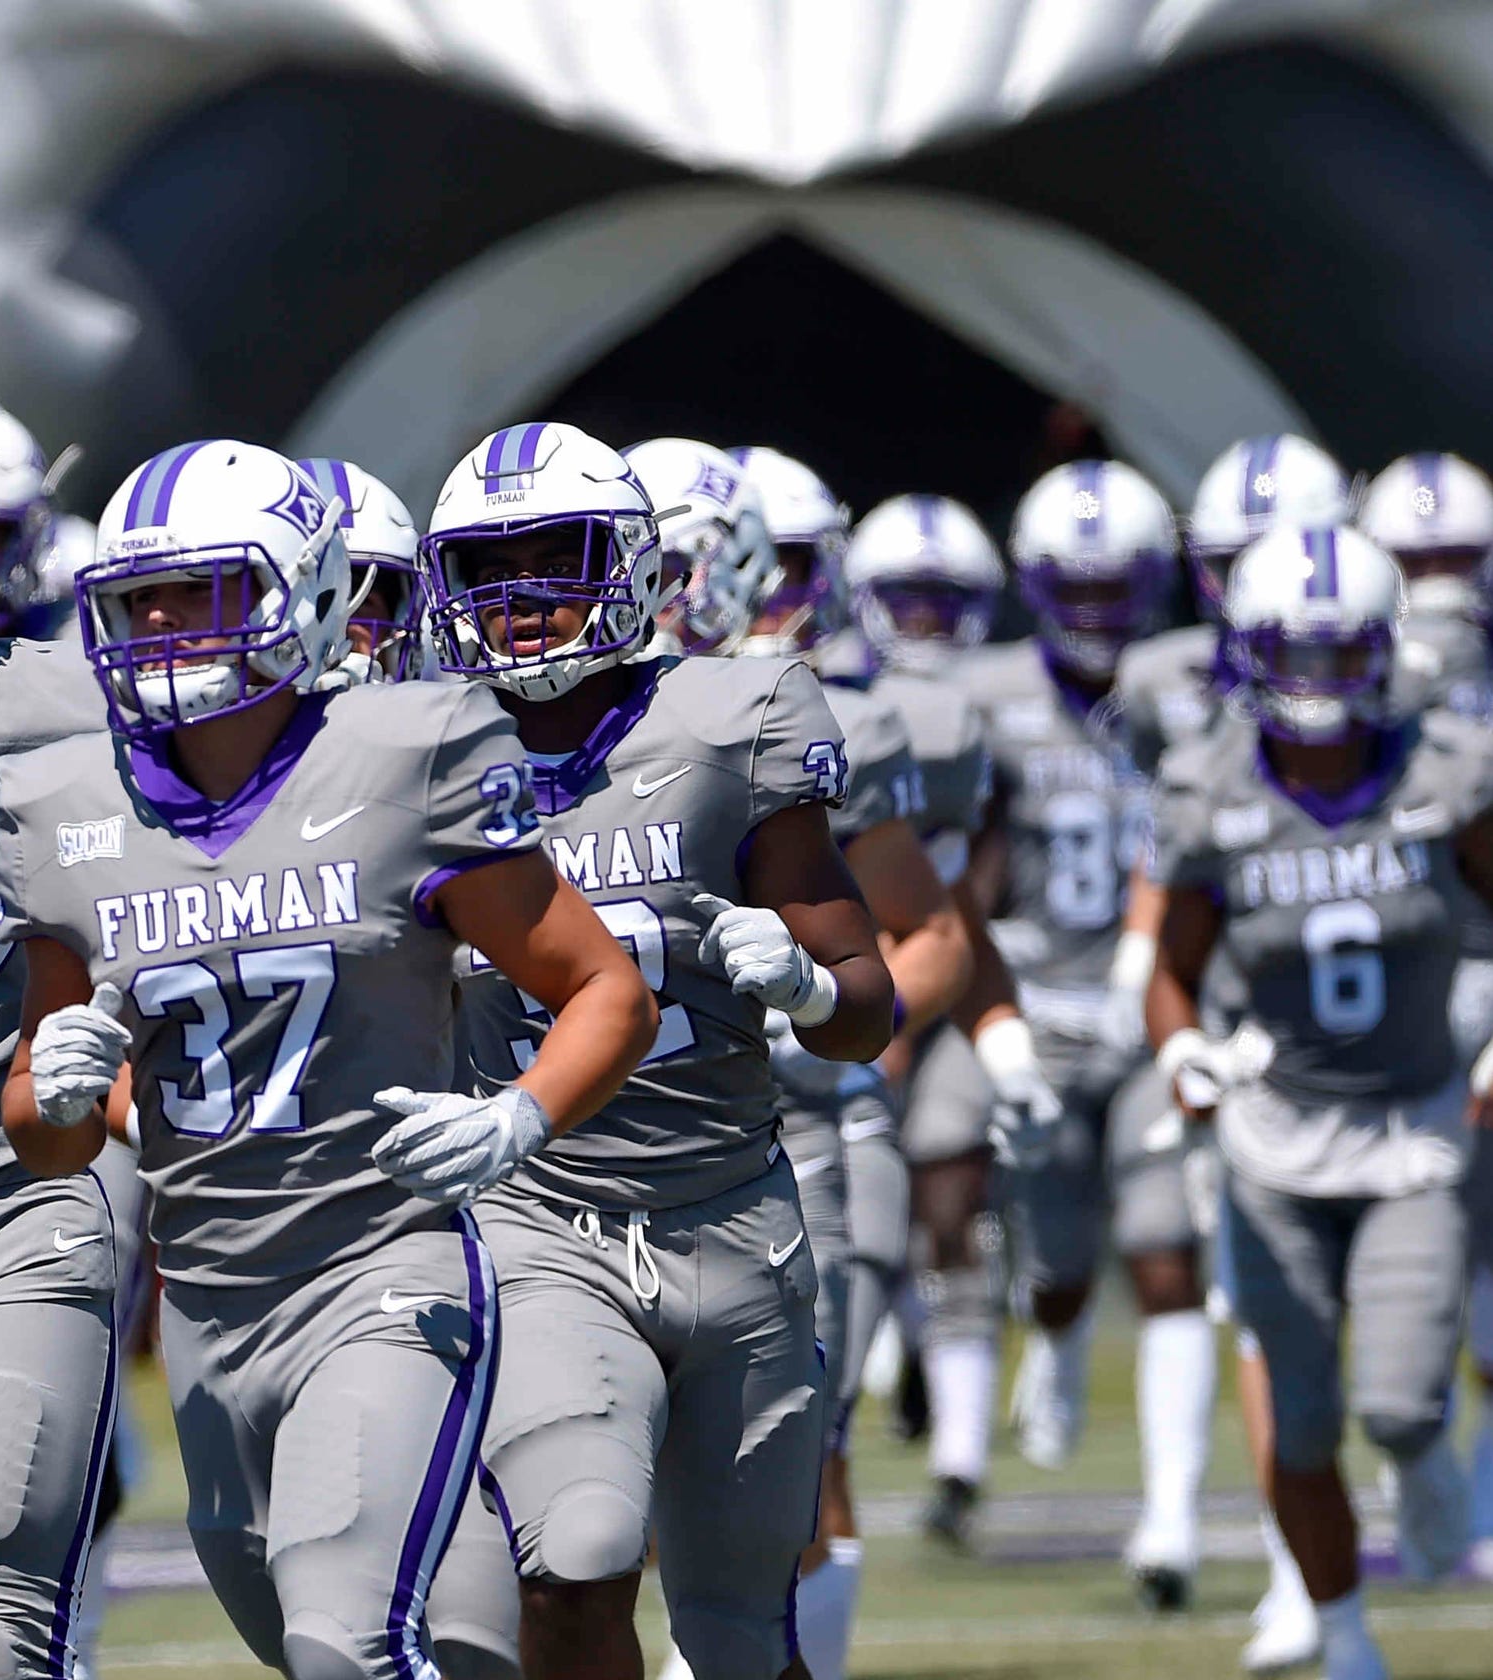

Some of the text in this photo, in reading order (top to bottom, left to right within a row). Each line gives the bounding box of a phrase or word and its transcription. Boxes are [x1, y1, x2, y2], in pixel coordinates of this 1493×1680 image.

[485, 491, 525, 506] FURMAN
[802, 740, 848, 798] 3
[550, 821, 684, 893] MAN
[95, 860, 360, 962] FURMAN
[1301, 898, 1387, 1036] 6
[130, 940, 338, 1138] 37
